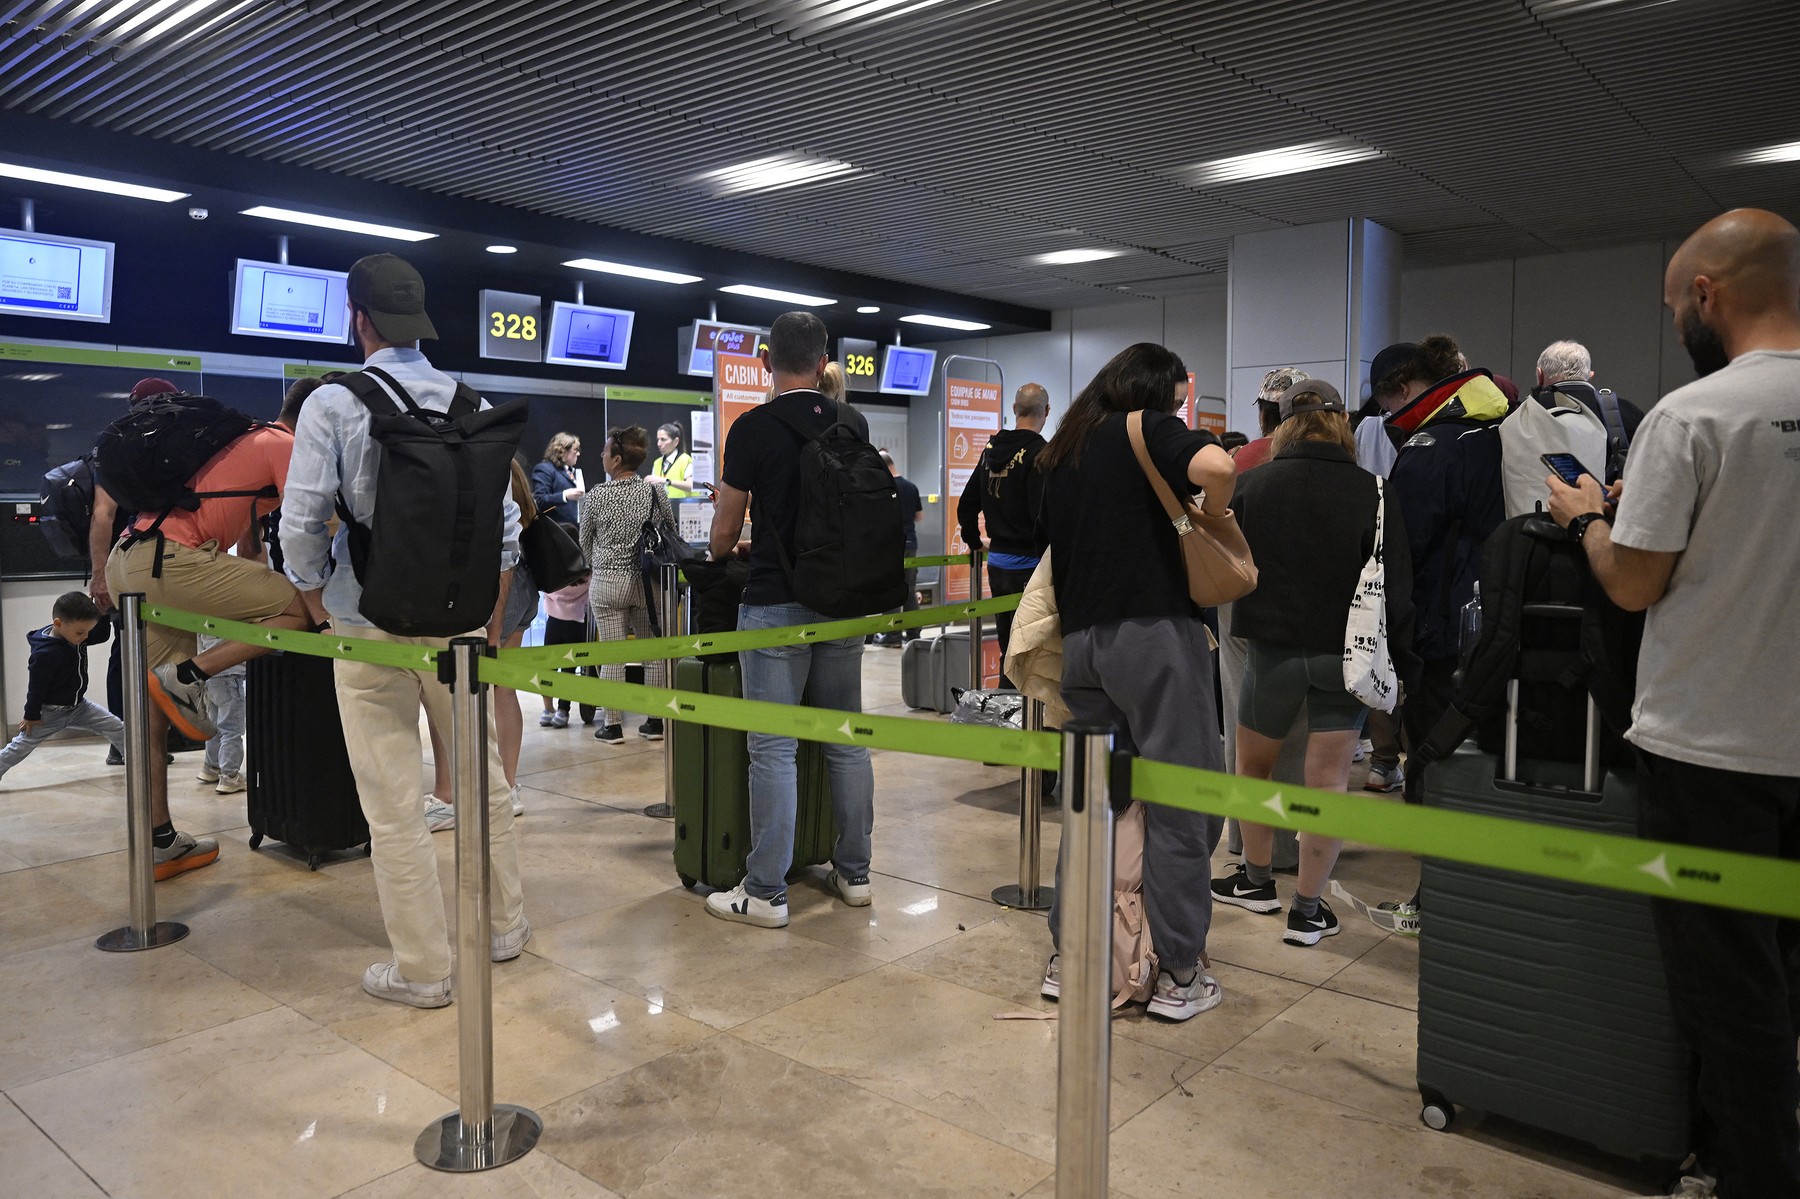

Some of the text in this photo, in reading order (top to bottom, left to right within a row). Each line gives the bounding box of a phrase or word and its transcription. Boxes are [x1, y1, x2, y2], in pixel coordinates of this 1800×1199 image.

[490, 312, 537, 341] 328
[709, 331, 744, 343] esyJet
[726, 342, 740, 350] plus
[846, 354, 874, 376] 326
[725, 364, 759, 386] CABIN
[735, 394, 761, 402] customers
[951, 385, 974, 399] EQUIPAJE
[974, 387, 982, 399] DE
[680, 703, 696, 711] aena
[854, 726, 874, 736] aena
[1288, 803, 1320, 816] aena
[1676, 866, 1722, 884] aena
